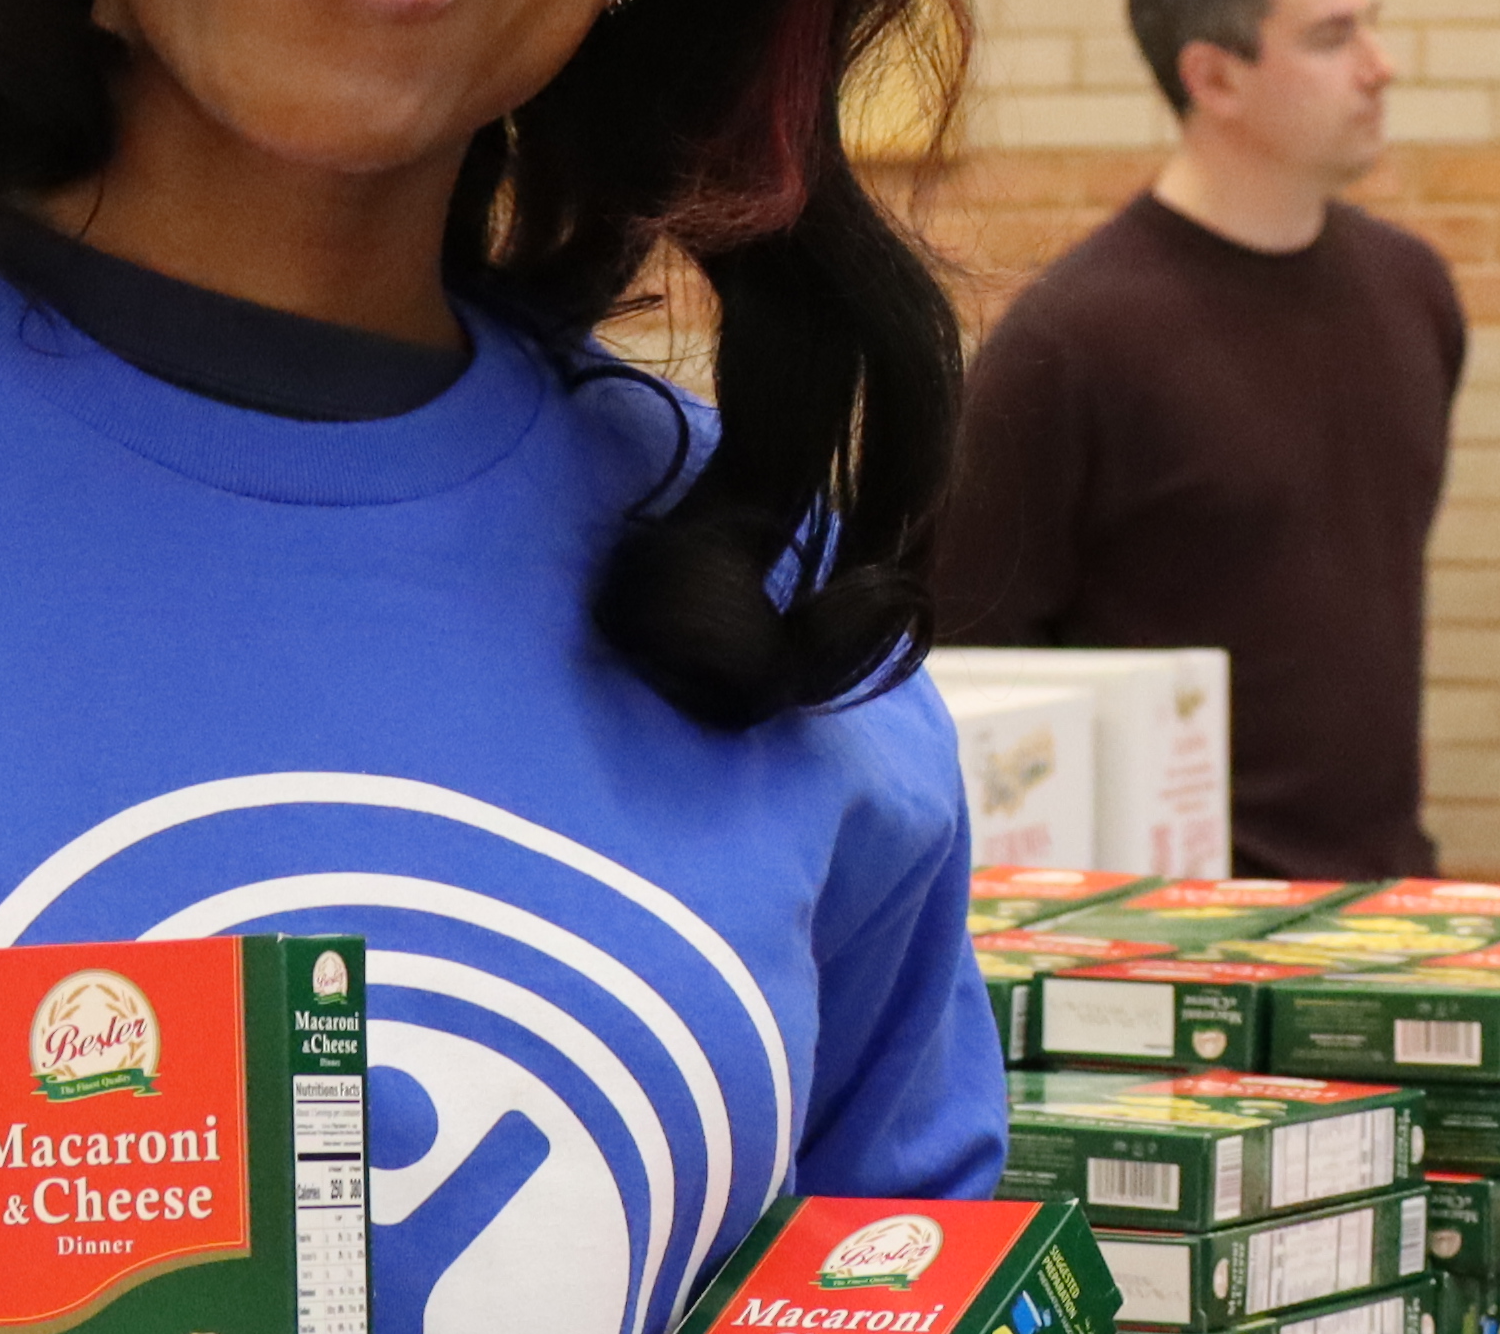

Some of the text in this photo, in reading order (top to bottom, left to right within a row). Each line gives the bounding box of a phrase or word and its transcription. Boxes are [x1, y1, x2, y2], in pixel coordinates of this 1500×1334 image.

[295, 1010, 360, 1031] Macaroni
[60, 1083, 75, 1096] The
[340, 1081, 361, 1097] Facts
[57, 1235, 135, 1256] Dinner
[1049, 1244, 1081, 1300] SUGGESTED
[1042, 1255, 1078, 1320] PREPARATION
[731, 1297, 945, 1333] Macaroni
